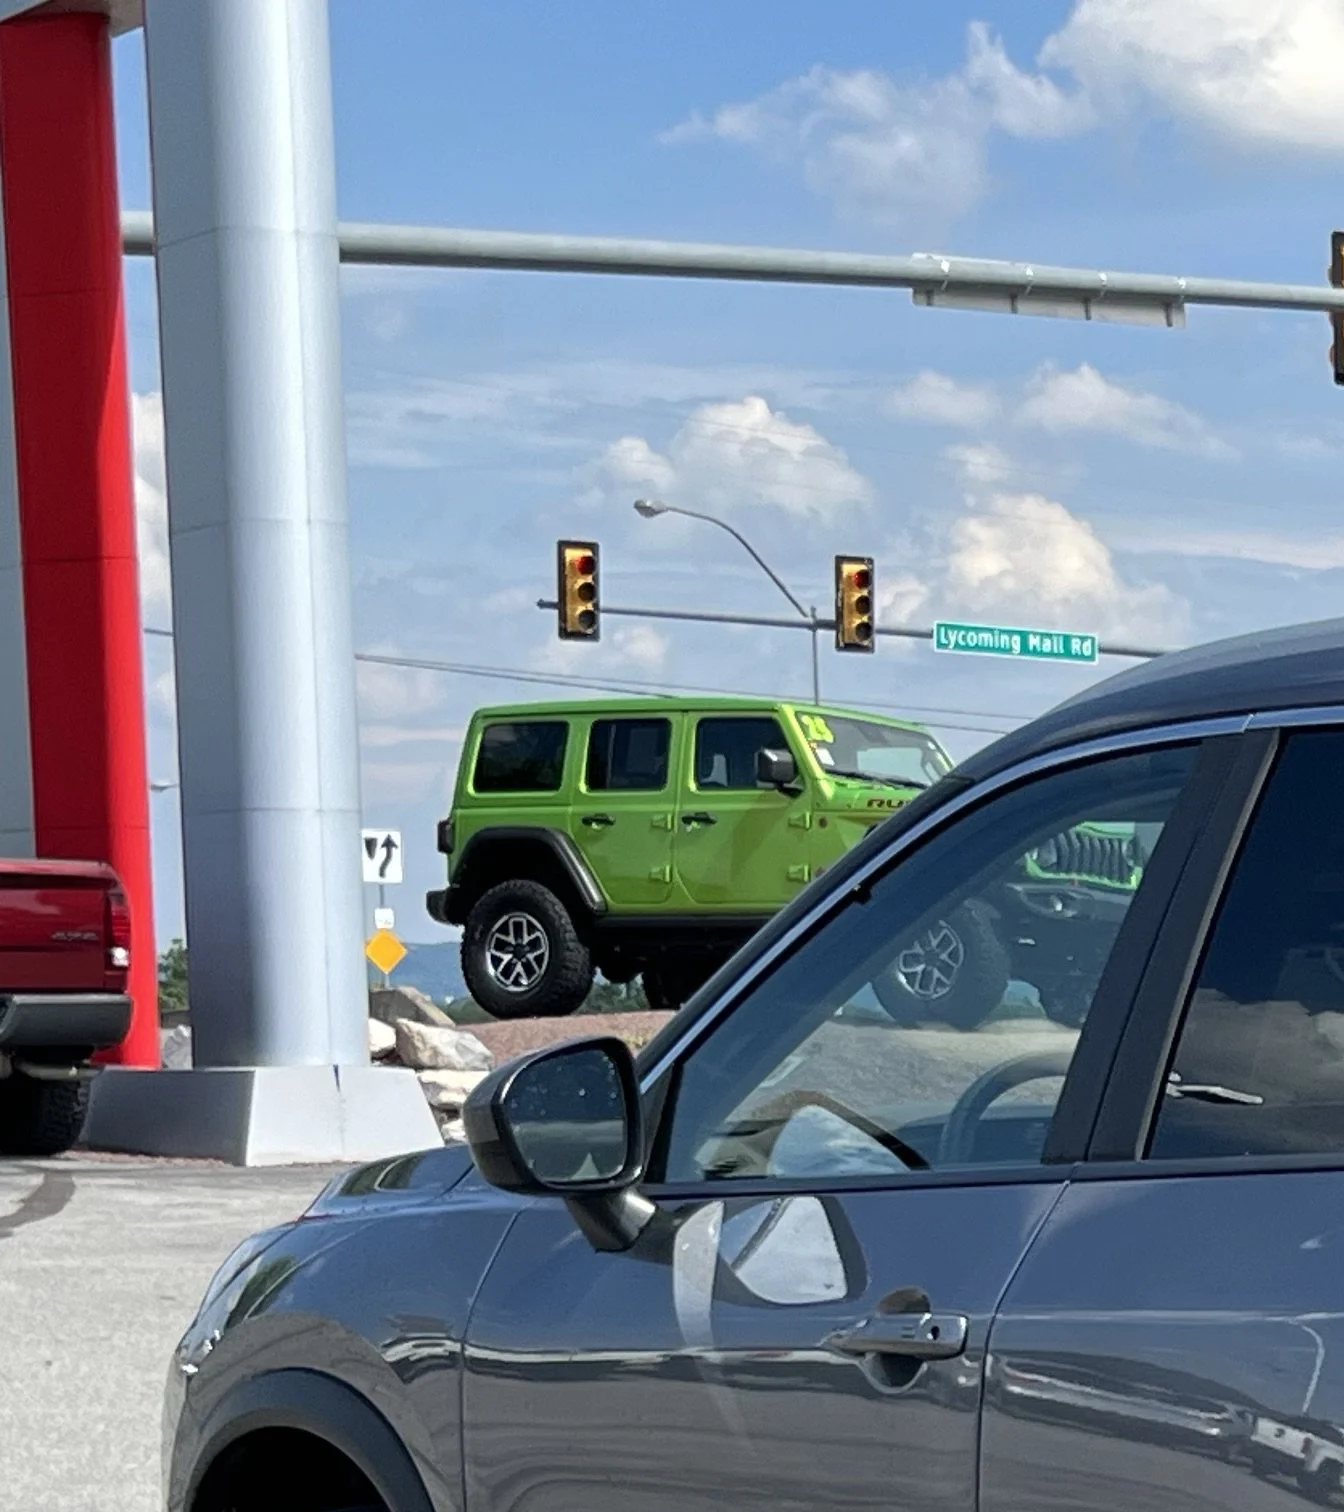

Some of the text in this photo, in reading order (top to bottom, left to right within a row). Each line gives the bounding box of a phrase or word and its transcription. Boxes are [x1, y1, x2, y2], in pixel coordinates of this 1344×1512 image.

[939, 626, 1092, 656] Lycoming Mall Rd
